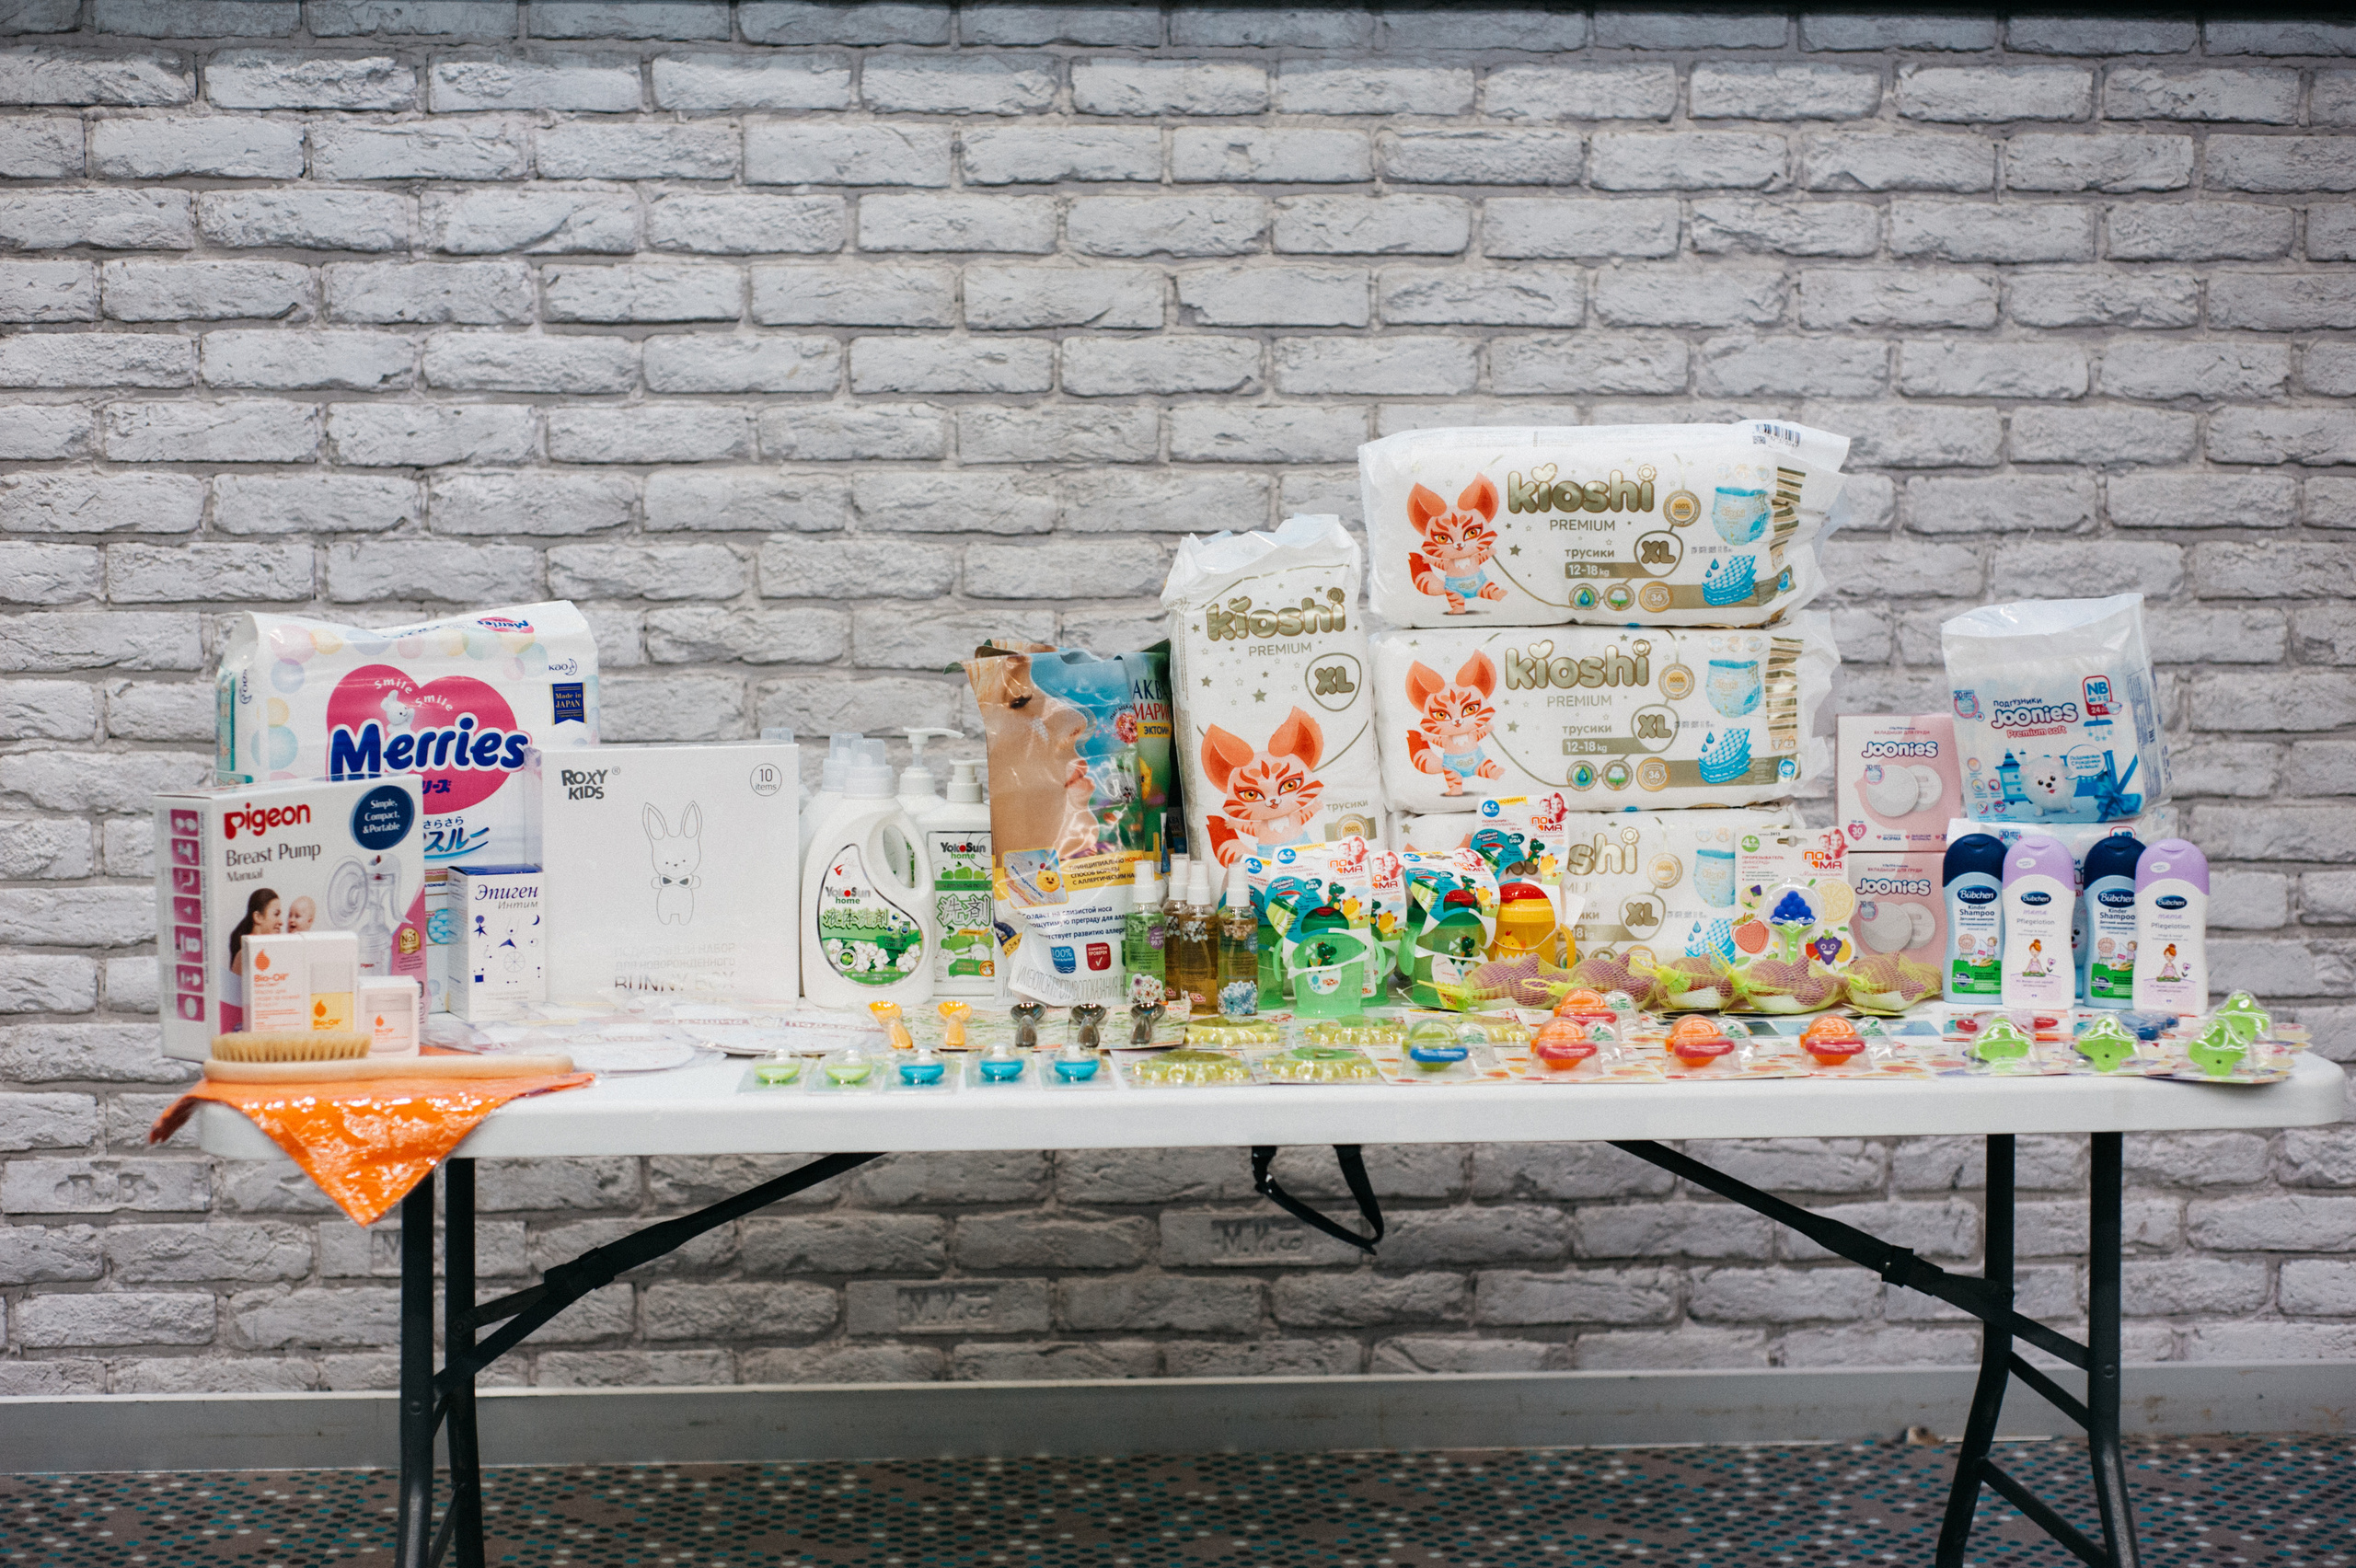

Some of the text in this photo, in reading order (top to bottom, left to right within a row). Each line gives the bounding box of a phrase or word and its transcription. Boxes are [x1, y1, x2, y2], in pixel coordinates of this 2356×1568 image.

[1507, 462, 1655, 514] kioshi
[1550, 519, 1615, 531] PREMIUM
[1565, 548, 1615, 559] трусики
[1641, 540, 1676, 564] XL
[1568, 565, 1610, 577] 12-18 kg
[1207, 587, 1346, 641] kioshi
[1248, 642, 1312, 656] PREMIUM
[1505, 639, 1652, 690] kioshi
[1314, 666, 1355, 696] XL
[2086, 682, 2108, 696] NB
[554, 700, 581, 709] JAPAN
[1547, 695, 1611, 708] PREMIUM
[1562, 724, 1612, 736] трусики
[1637, 714, 1672, 739] XL
[2007, 725, 2067, 738] Premium soft
[330, 717, 529, 776] Merries
[1566, 742, 1608, 754] 12-18 kg
[561, 769, 608, 787] ROXY
[759, 768, 773, 782] 10
[568, 786, 605, 800] KIDS
[755, 783, 777, 791] items
[370, 799, 398, 811] Simple,
[1326, 800, 1369, 813] трусики
[224, 802, 311, 840] pigeon
[364, 811, 400, 823] Compact,
[424, 826, 491, 853] スルー
[941, 842, 986, 853] YokoSun
[226, 844, 321, 867] Breast Pump
[951, 851, 976, 859] home
[1125, 855, 1143, 863] НОВЫЙ
[226, 868, 263, 882] Manual
[475, 883, 538, 901] Эпиген
[826, 886, 871, 898] YokoSun
[1960, 890, 1994, 900] Bübchen
[498, 901, 538, 910] Интим
[1625, 902, 1658, 927] XL
[1959, 909, 1995, 917] Shampoo
[2099, 912, 2135, 921] Shampoo
[1028, 918, 1069, 929] ощутимую
[1071, 917, 1100, 927] преграду
[1074, 930, 1104, 940] развитию
[1052, 949, 1072, 958] 100%
